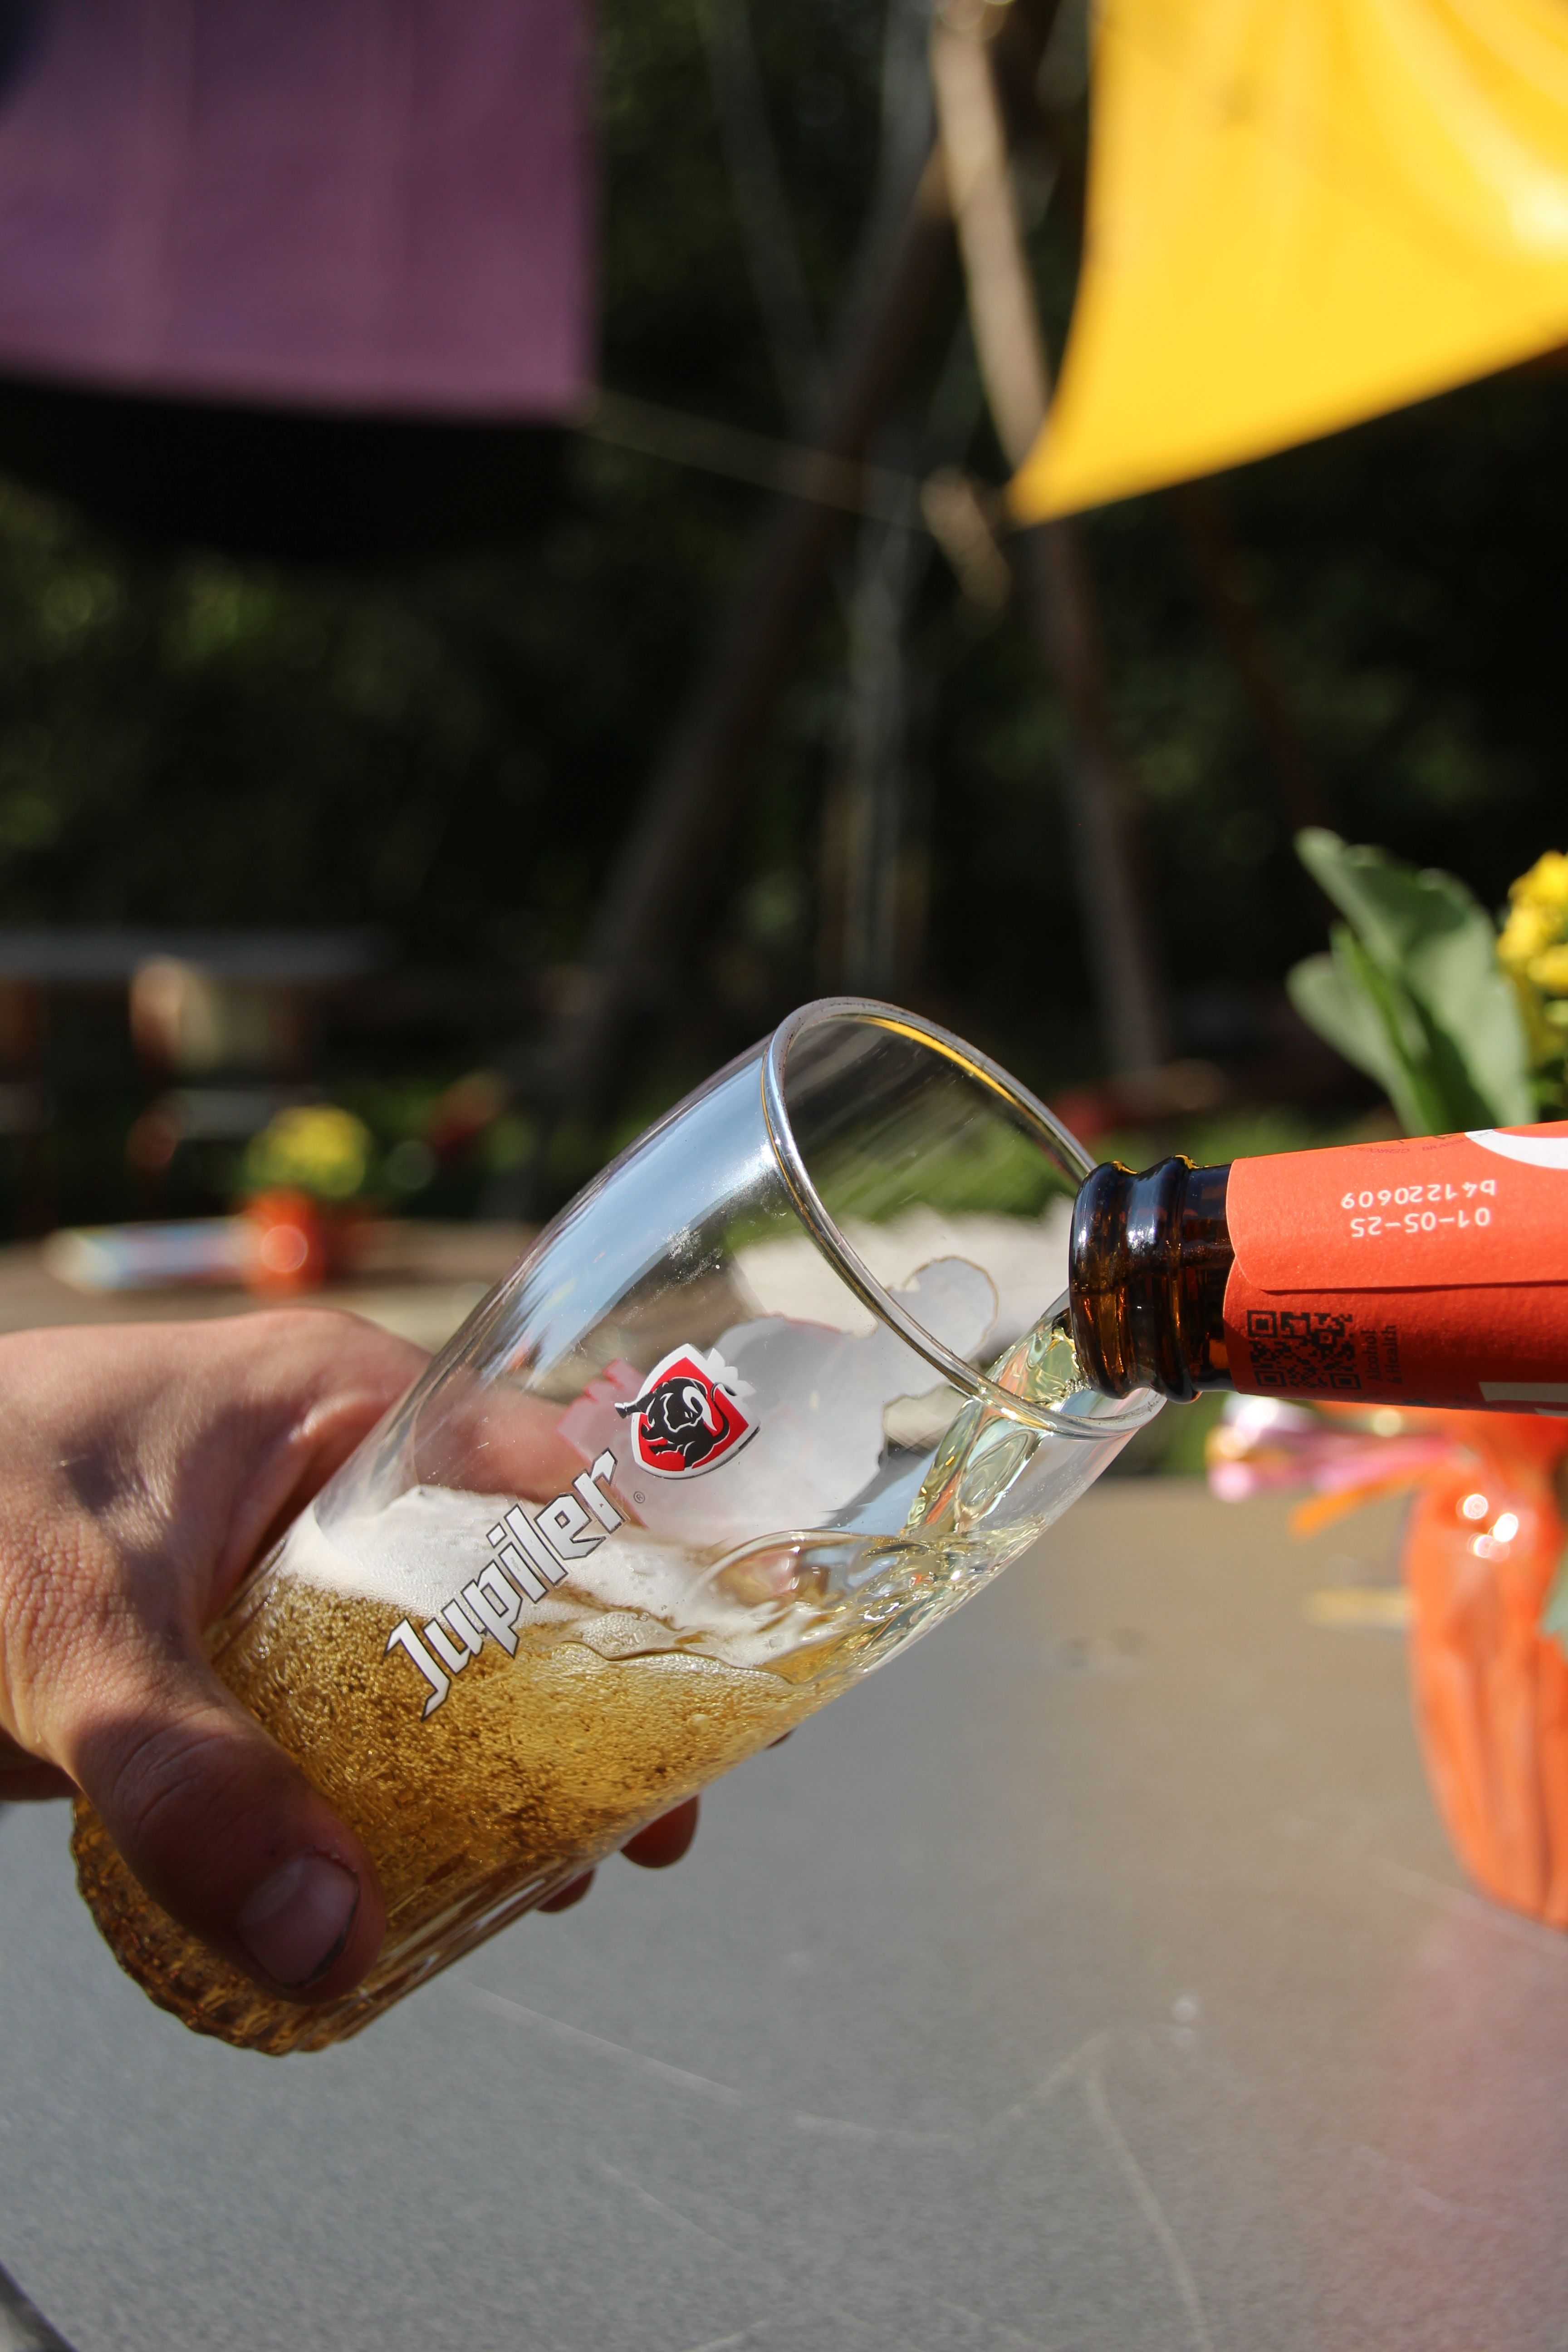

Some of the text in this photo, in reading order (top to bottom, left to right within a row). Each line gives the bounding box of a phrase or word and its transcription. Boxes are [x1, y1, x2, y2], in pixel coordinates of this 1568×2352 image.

[1340, 1179, 1496, 1210] b41220609
[1349, 1206, 1491, 1239] 01-05-25
[1361, 1329, 1382, 1381] Alcohol
[1381, 1325, 1401, 1373] Health
[382, 1448, 631, 1723] Jupiler
